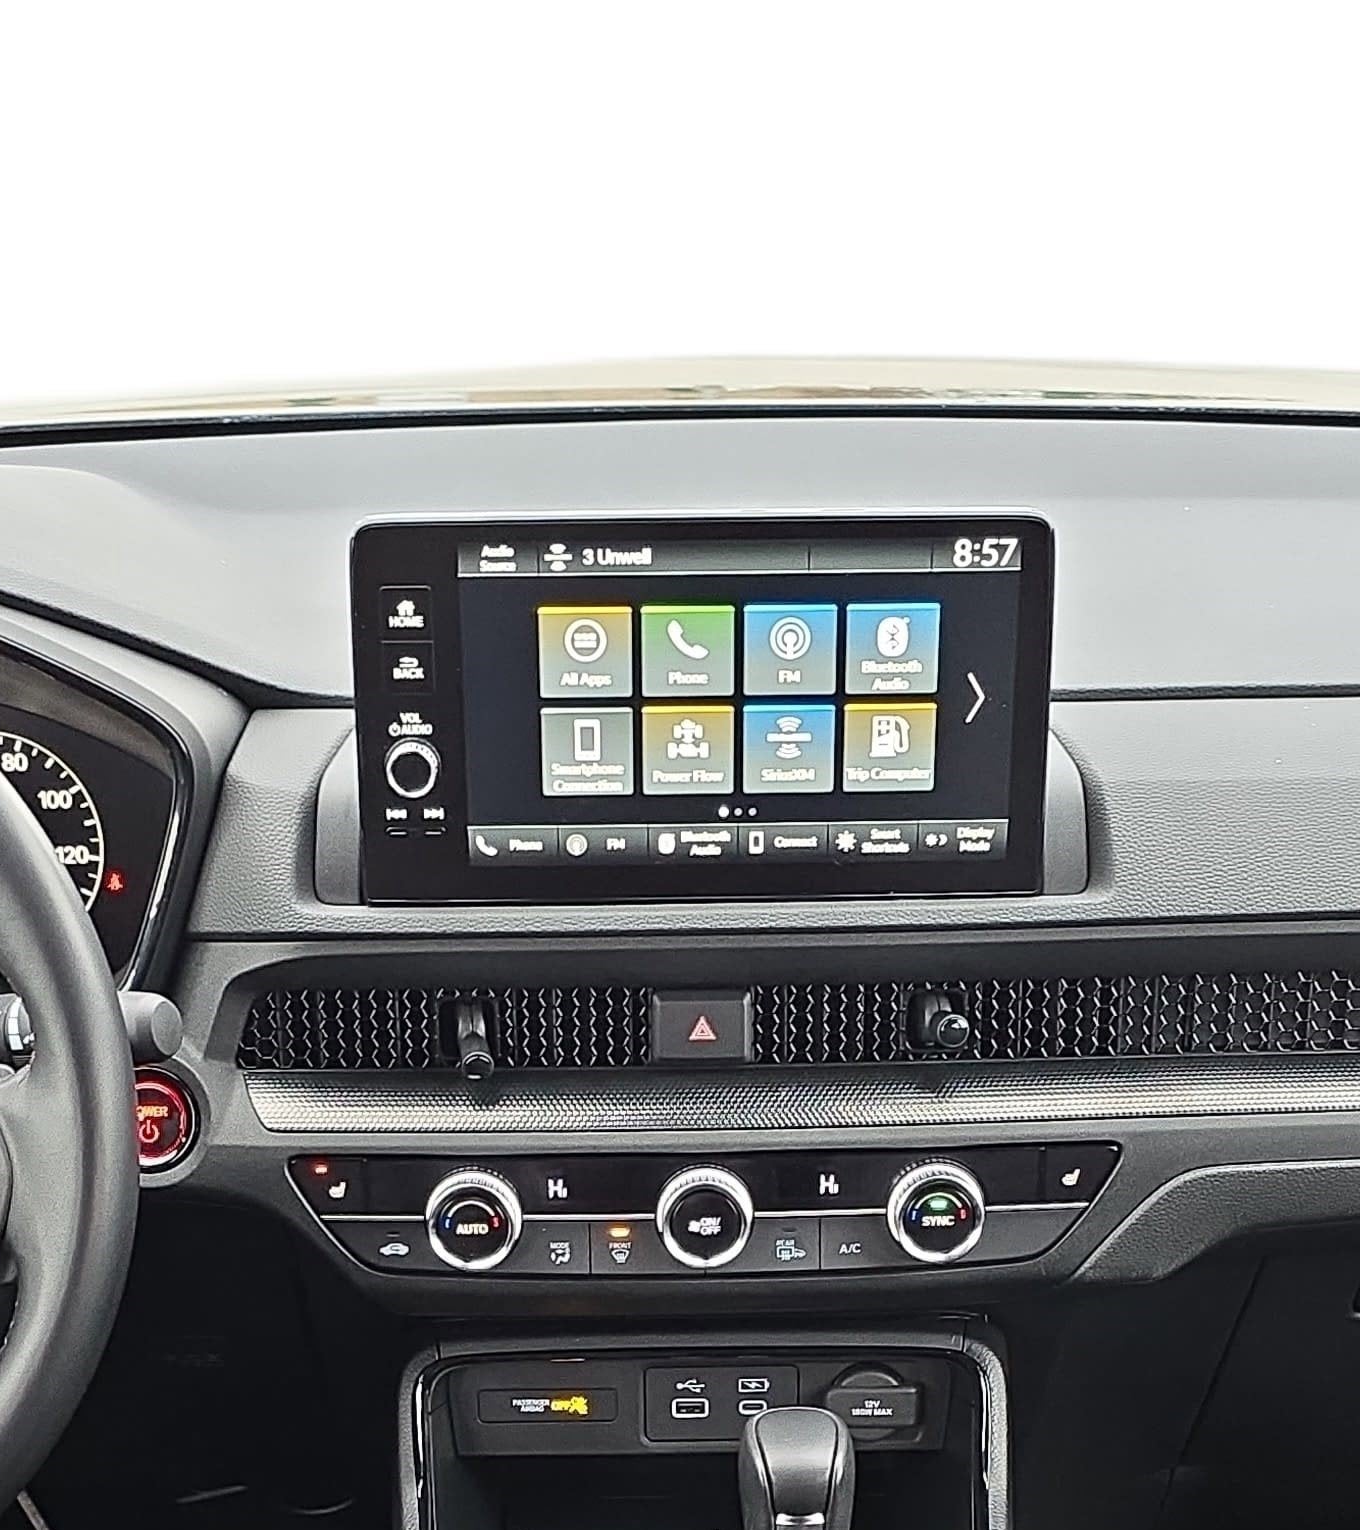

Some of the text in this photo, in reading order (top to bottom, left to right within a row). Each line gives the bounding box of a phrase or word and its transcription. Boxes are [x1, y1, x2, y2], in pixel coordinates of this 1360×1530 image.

[581, 547, 653, 566] 3 Unwell
[952, 537, 1019, 567] 8:57
[388, 615, 424, 628] HOME
[392, 667, 425, 680] BACK
[559, 672, 613, 689] All Apps
[667, 671, 709, 686] Phone
[777, 669, 801, 684] FM
[871, 676, 910, 691] Audio
[400, 712, 423, 724] VOL
[400, 723, 433, 736] AUDIO
[1, 753, 29, 772] 80
[652, 769, 725, 784] Power Flow
[846, 767, 870, 782] Trip
[37, 790, 73, 809] 100
[606, 837, 626, 851] FM
[54, 845, 90, 864] 120
[135, 1105, 168, 1118] OWER
[921, 1215, 956, 1227] SYNC
[455, 1223, 489, 1236] AUTO
[700, 1225, 721, 1236] OFF
[839, 1243, 862, 1255] A/C
[873, 1408, 893, 1416] MAX
